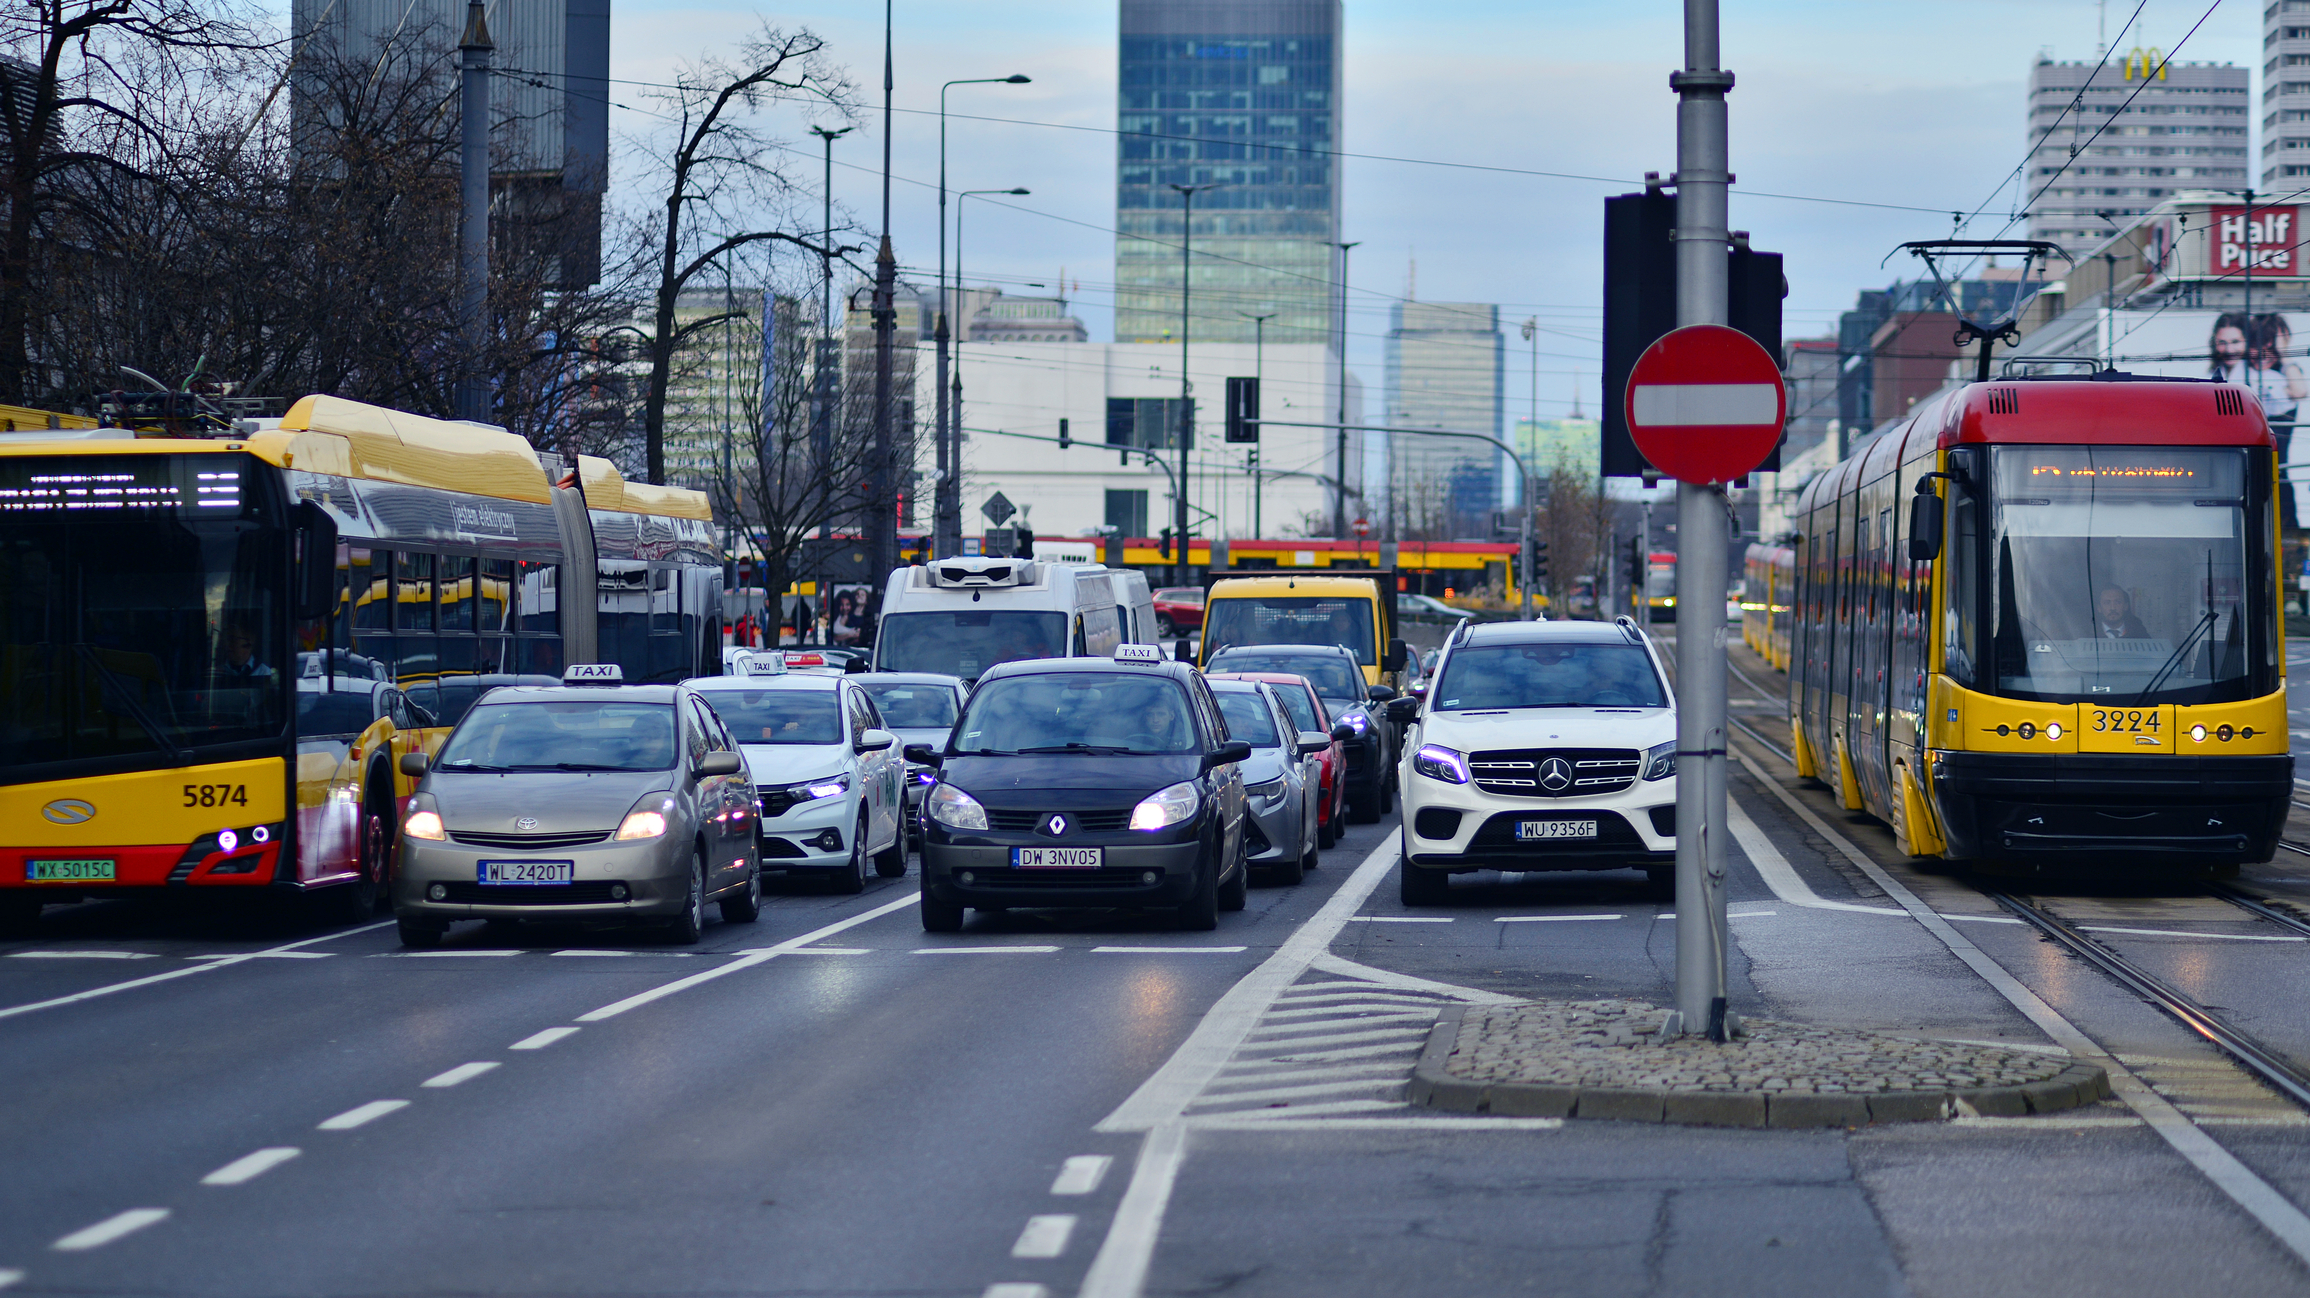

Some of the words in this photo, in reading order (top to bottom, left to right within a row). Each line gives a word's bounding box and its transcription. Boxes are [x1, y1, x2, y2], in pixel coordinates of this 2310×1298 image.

[2220, 213, 2291, 244] Half
[2220, 243, 2291, 269] Price
[453, 501, 479, 529] jestem
[1123, 649, 1151, 657] TAXI
[573, 666, 613, 677] TAXI
[2092, 710, 2162, 733] 3224
[183, 784, 248, 807] 5874
[1524, 823, 1544, 837] WU
[1550, 821, 1595, 837] 9356F
[1023, 850, 1042, 865] DW
[1049, 850, 1096, 865] 3NV05
[36, 862, 57, 877] WX
[63, 862, 111, 877] 5015C
[490, 865, 509, 880] WL
[516, 865, 567, 880] 2420T
